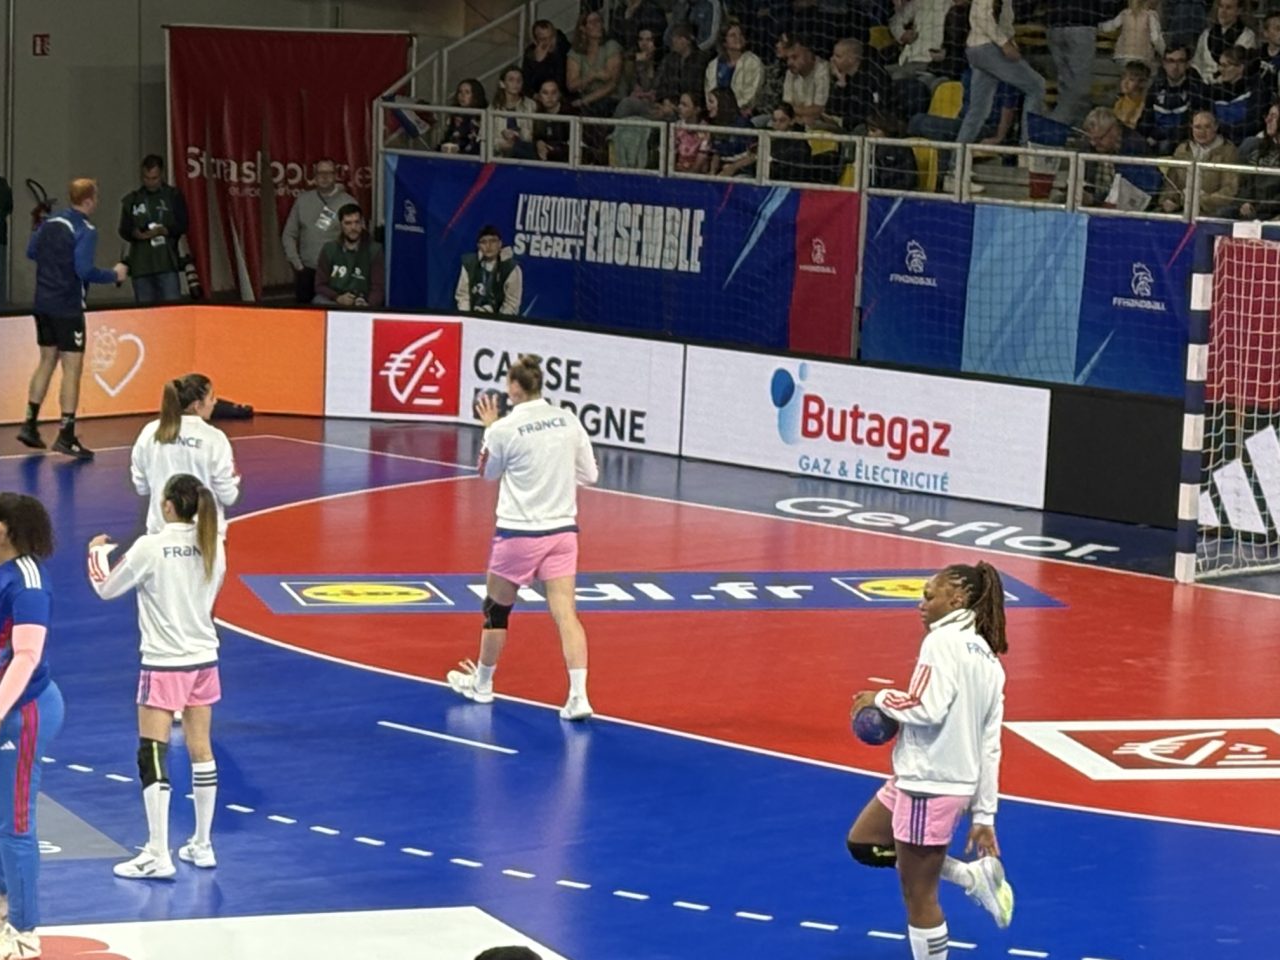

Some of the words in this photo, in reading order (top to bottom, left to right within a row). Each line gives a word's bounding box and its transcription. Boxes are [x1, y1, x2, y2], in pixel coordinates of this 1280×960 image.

[515, 193, 587, 236] L'HISTOIRE
[585, 199, 705, 273] ENSEMBLE
[512, 232, 584, 261] S'ÉCRIT
[473, 347, 583, 394] CASE
[800, 393, 952, 461] Butagaz
[798, 454, 832, 475] GAZ
[838, 460, 849, 477] &
[855, 459, 950, 492] ÉLECTRICITÉ
